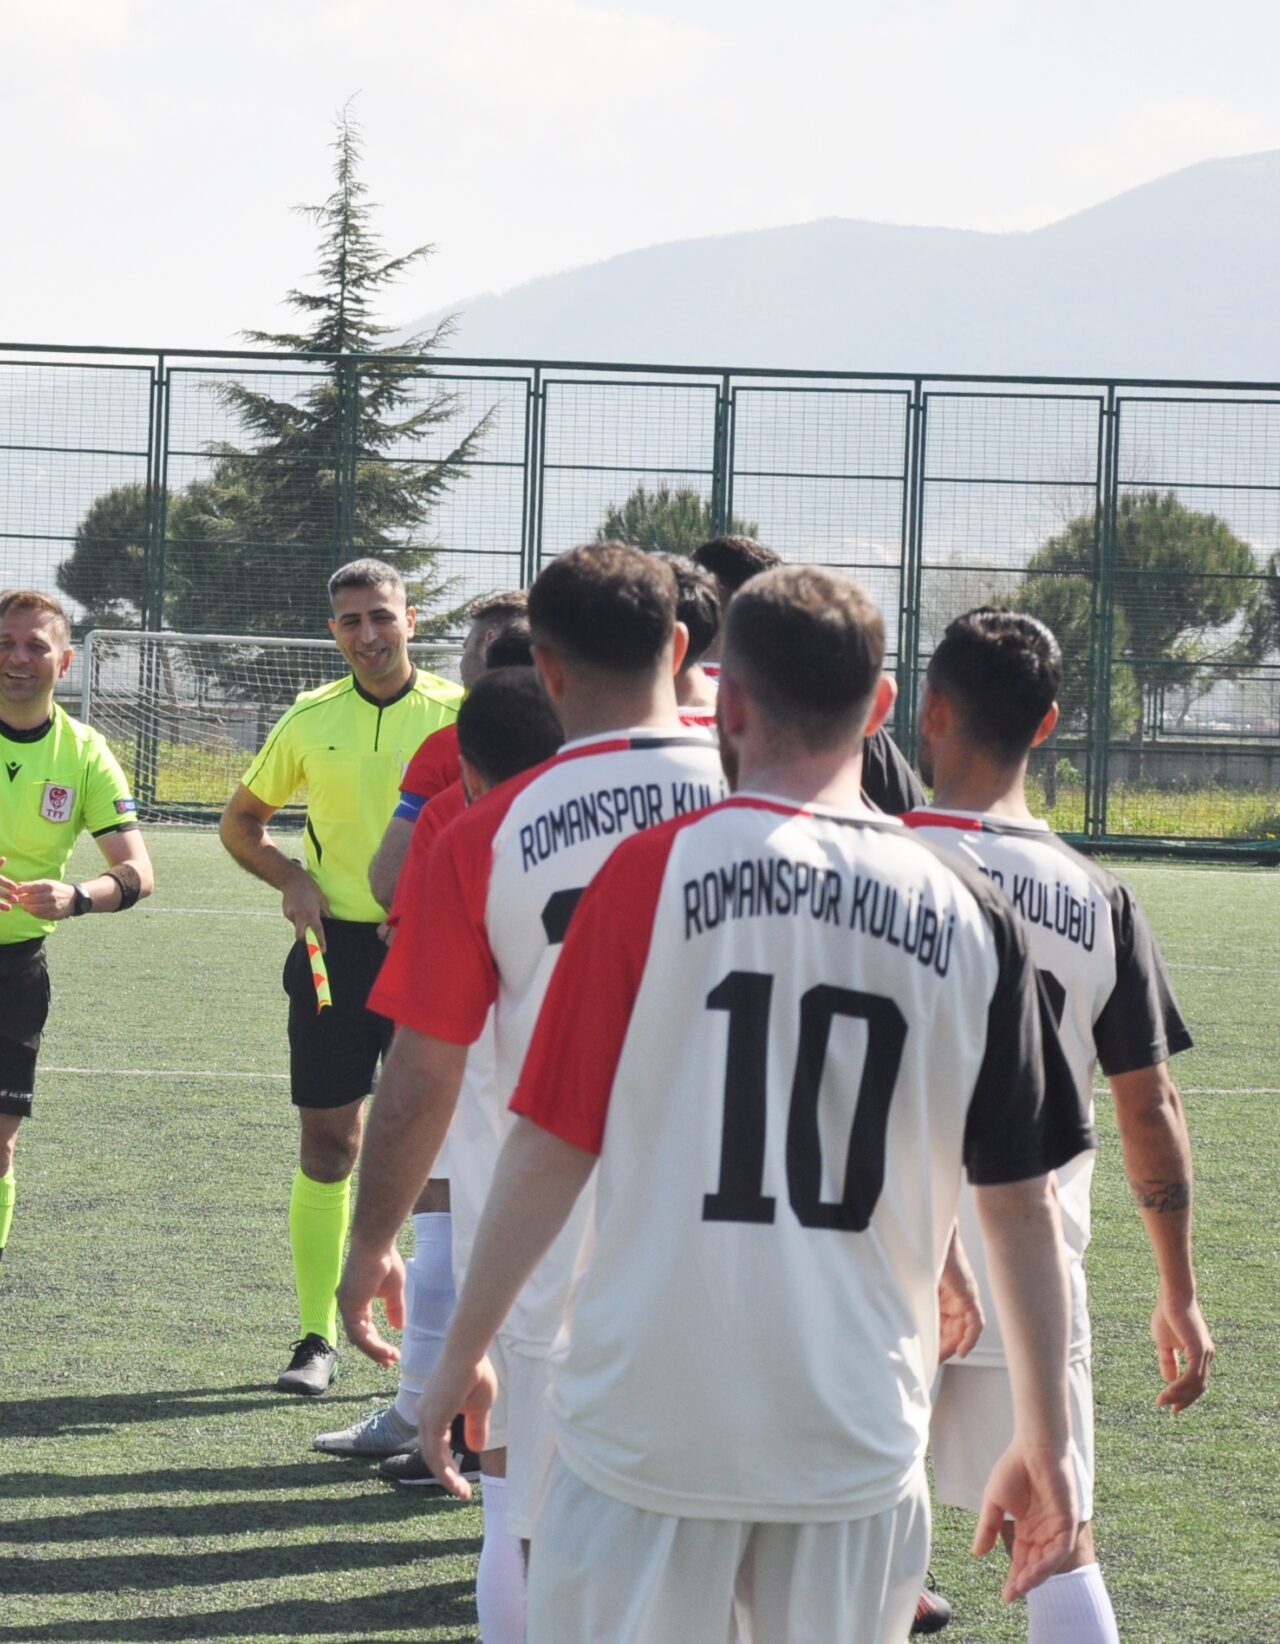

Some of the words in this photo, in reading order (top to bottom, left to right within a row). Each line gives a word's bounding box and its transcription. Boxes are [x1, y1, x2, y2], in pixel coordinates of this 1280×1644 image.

[46, 808, 65, 819] TFF
[520, 784, 664, 873] ROMANSPOR
[684, 858, 841, 940] ROMANSPOR
[849, 874, 955, 978] KULÜBÜ
[1012, 873, 1096, 953] KULÜBÜ
[701, 970, 909, 1233] 10
